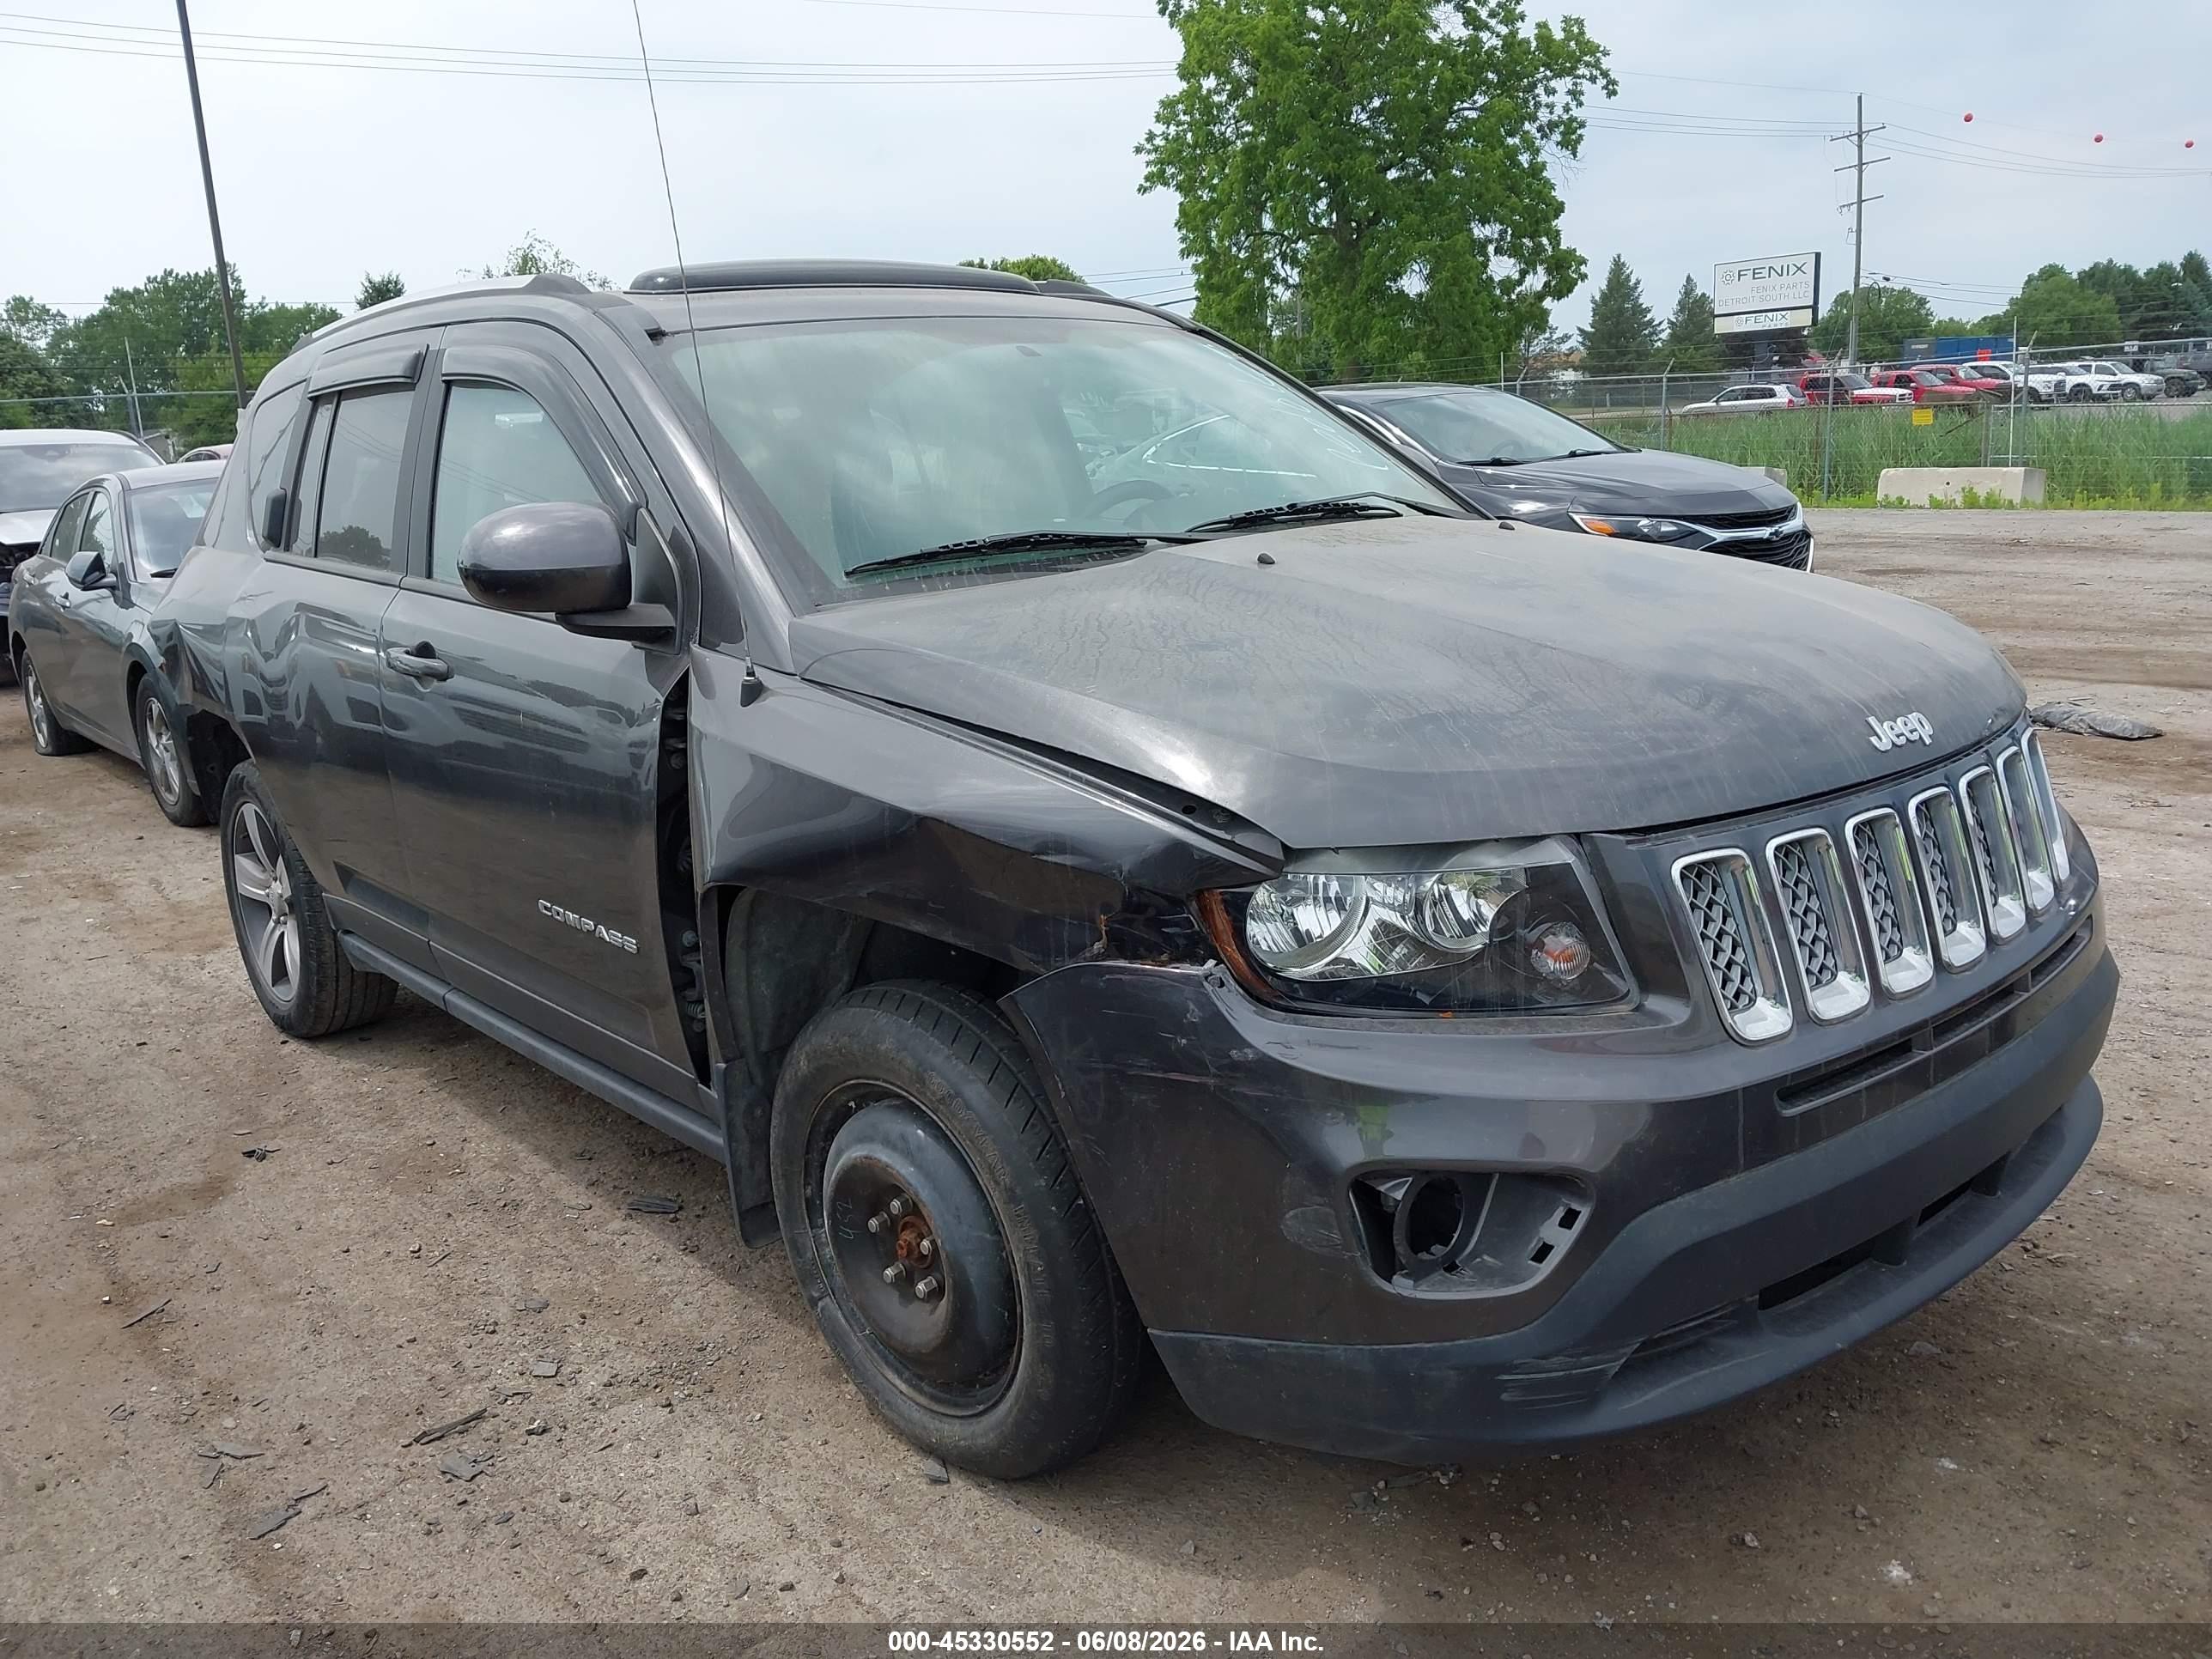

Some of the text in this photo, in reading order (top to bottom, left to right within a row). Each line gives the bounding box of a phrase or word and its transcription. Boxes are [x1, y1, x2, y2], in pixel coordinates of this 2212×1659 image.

[1737, 262, 1808, 282] FENIX
[1751, 282, 1810, 295] FENIX PARTS
[1718, 291, 1810, 307] DETROIT SOUTH LLC
[1744, 312, 1789, 325] FENIX
[1865, 712, 1934, 751] Jeep
[538, 899, 639, 954] COMPASS
